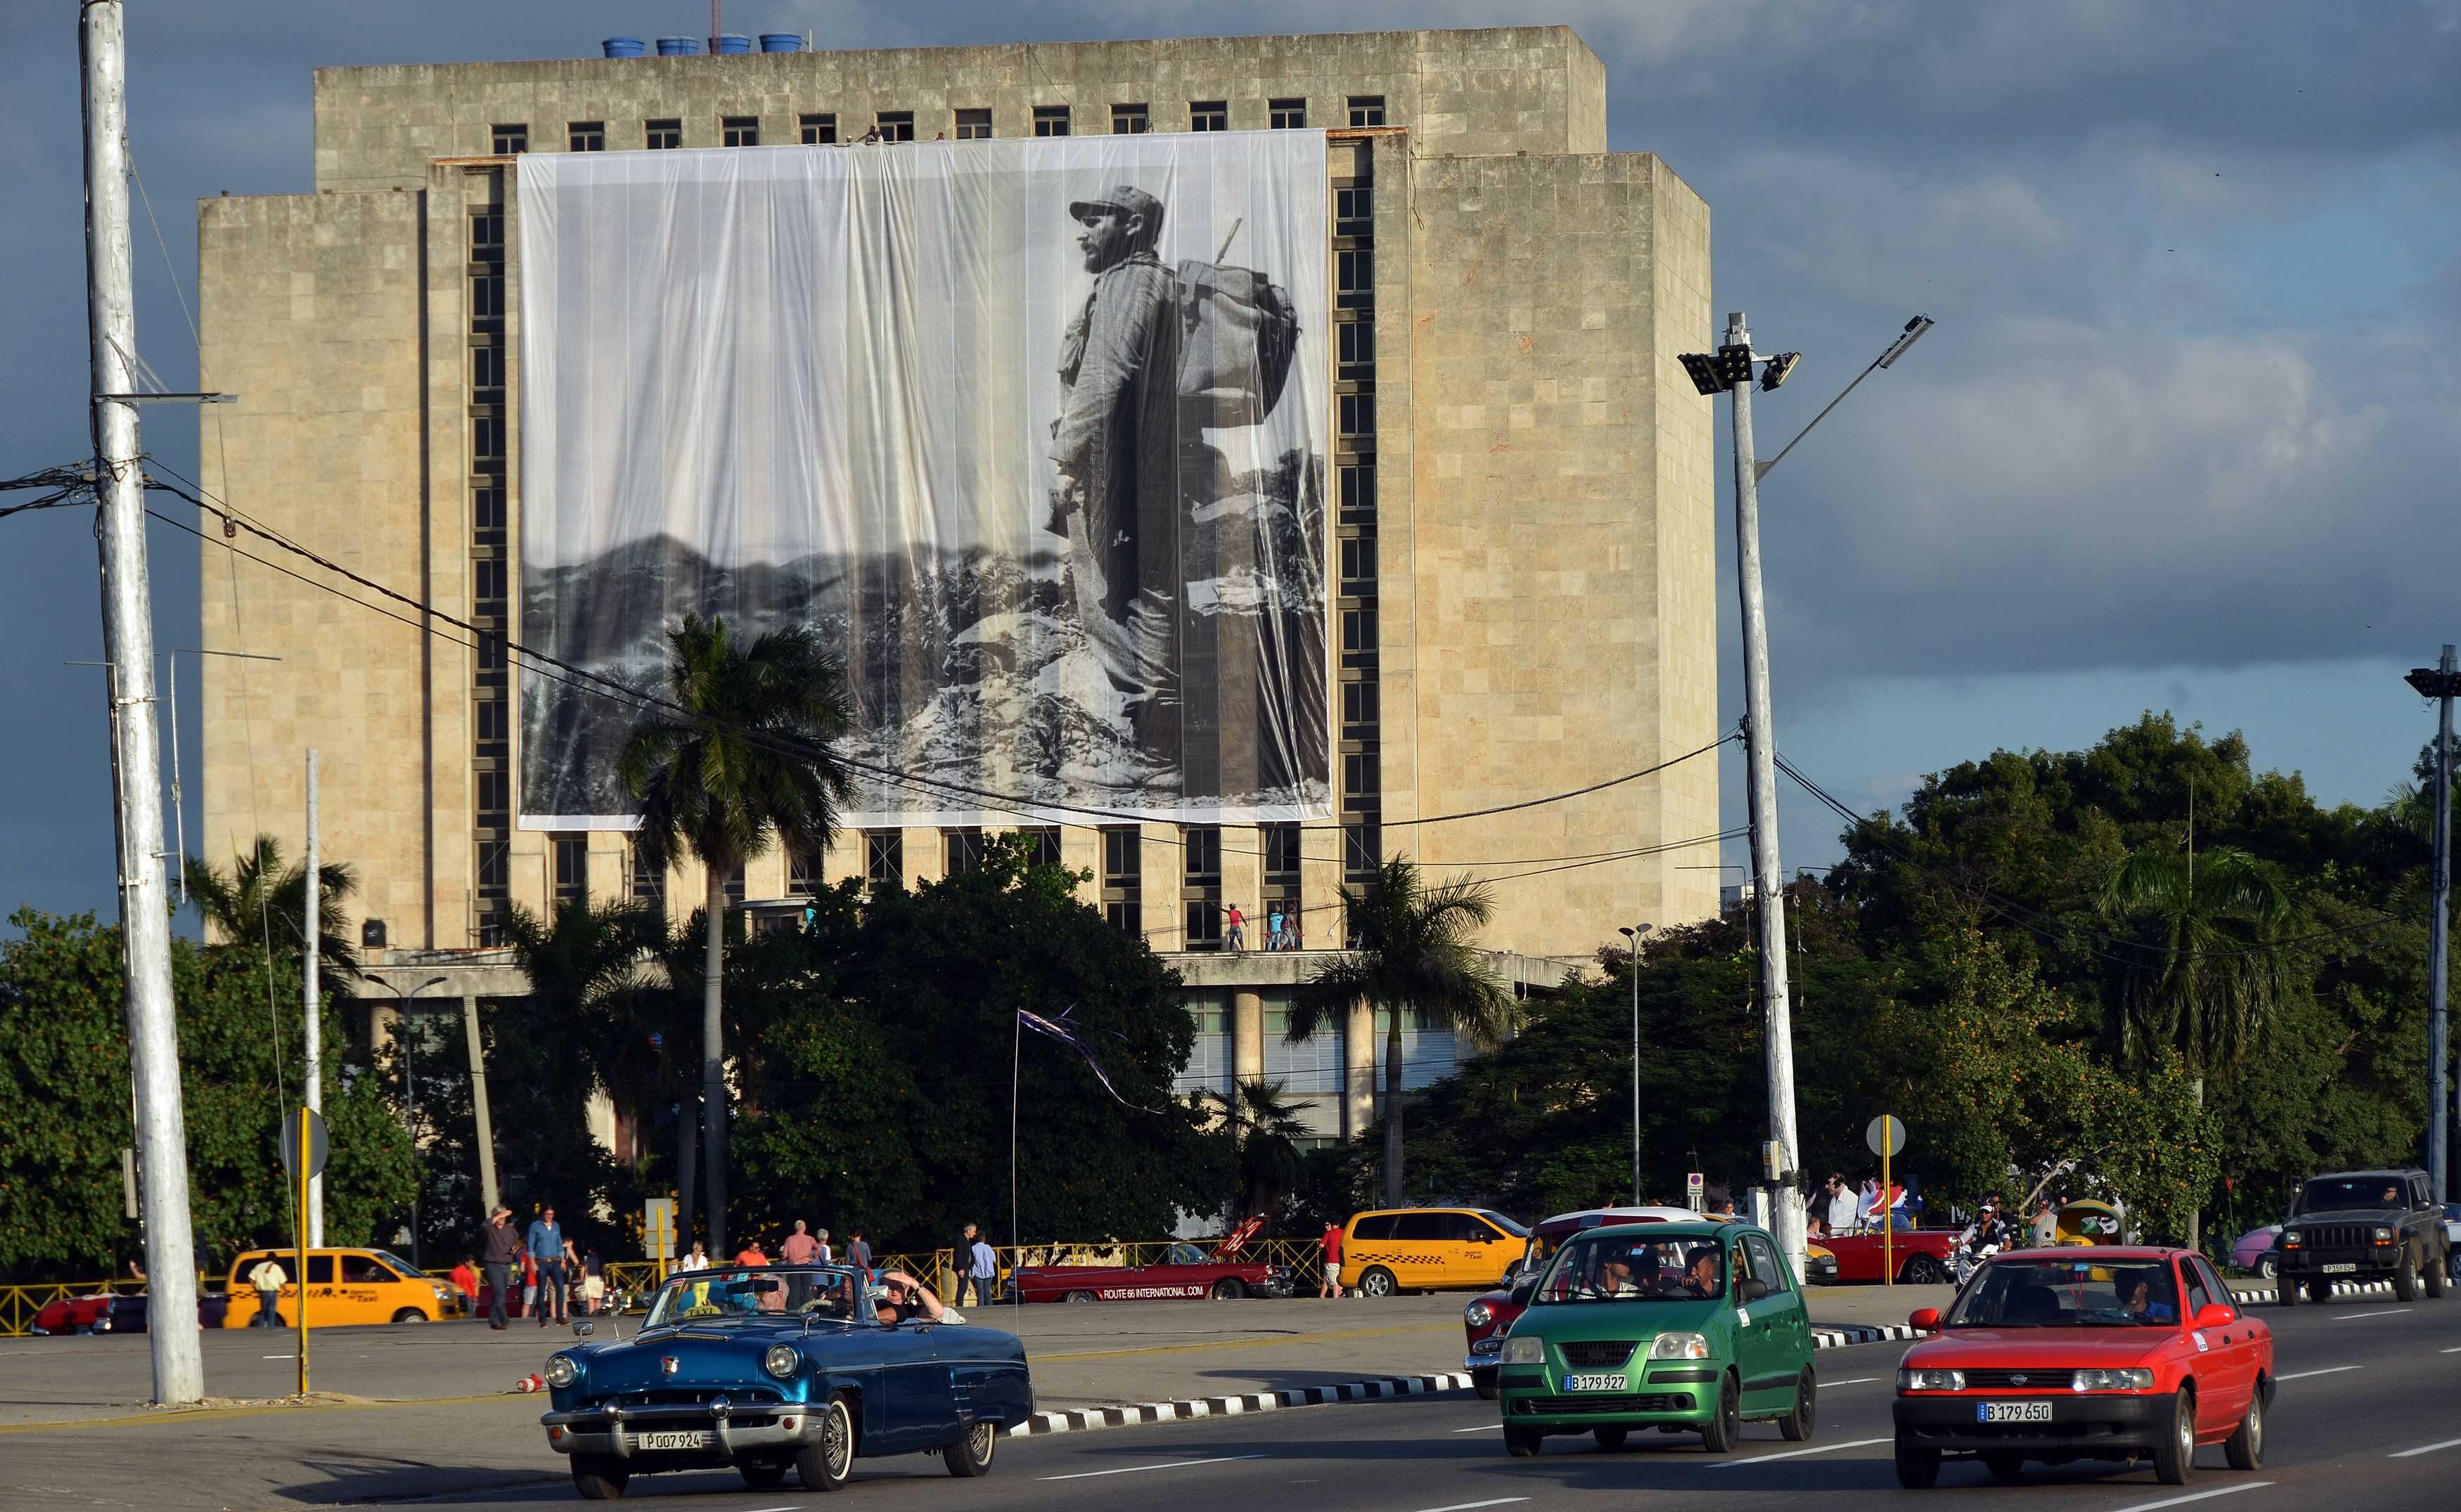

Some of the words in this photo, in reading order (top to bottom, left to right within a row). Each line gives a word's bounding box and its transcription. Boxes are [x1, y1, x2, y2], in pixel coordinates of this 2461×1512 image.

[1104, 1289, 1126, 1299] ROUTE
[1127, 1288, 1136, 1298] 66
[1136, 1287, 1185, 1298] INTERNATIONAL
[688, 1307, 713, 1317] TAXI
[1573, 1377, 1579, 1389] B
[1581, 1376, 1602, 1389] 179
[1604, 1376, 1625, 1389] 927
[1988, 1406, 1996, 1420] B
[1998, 1405, 2022, 1420] 179
[2025, 1404, 2049, 1419] 650
[647, 1435, 654, 1448] P
[656, 1435, 676, 1448] 007
[679, 1434, 700, 1447] 924
